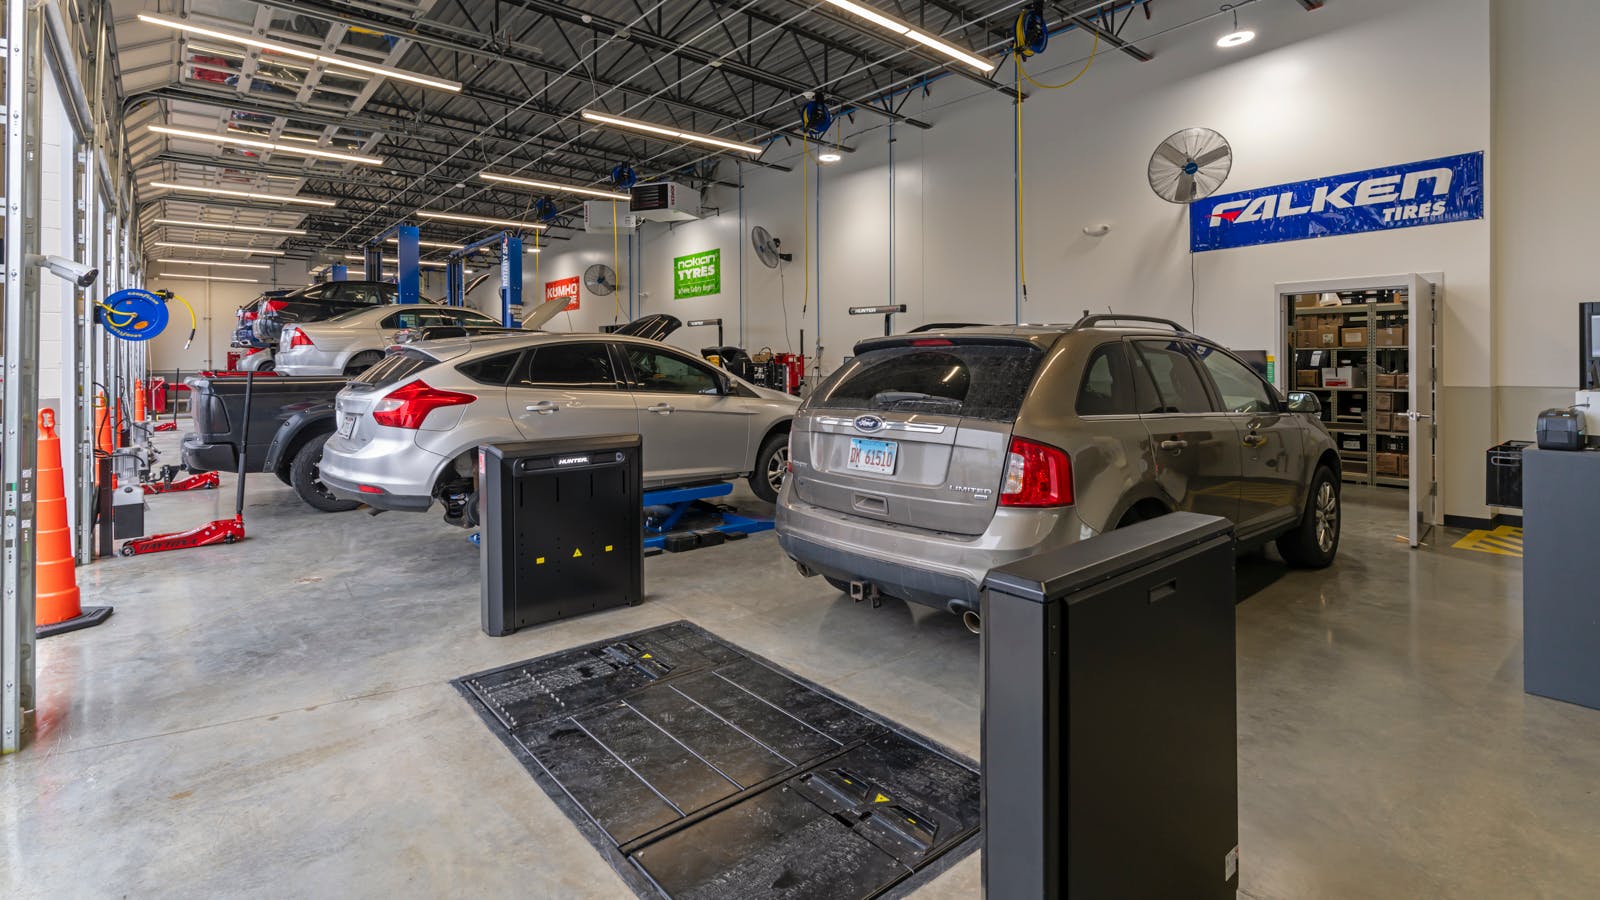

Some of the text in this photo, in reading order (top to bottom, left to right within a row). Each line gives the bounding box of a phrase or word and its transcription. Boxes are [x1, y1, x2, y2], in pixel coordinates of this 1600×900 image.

[1204, 167, 1453, 228] FALKEN
[1382, 200, 1447, 222] TIRES
[678, 264, 716, 281] TYRES
[547, 283, 578, 299] KUMHO
[865, 449, 893, 468] 61510
[949, 484, 992, 495] LIMITED
